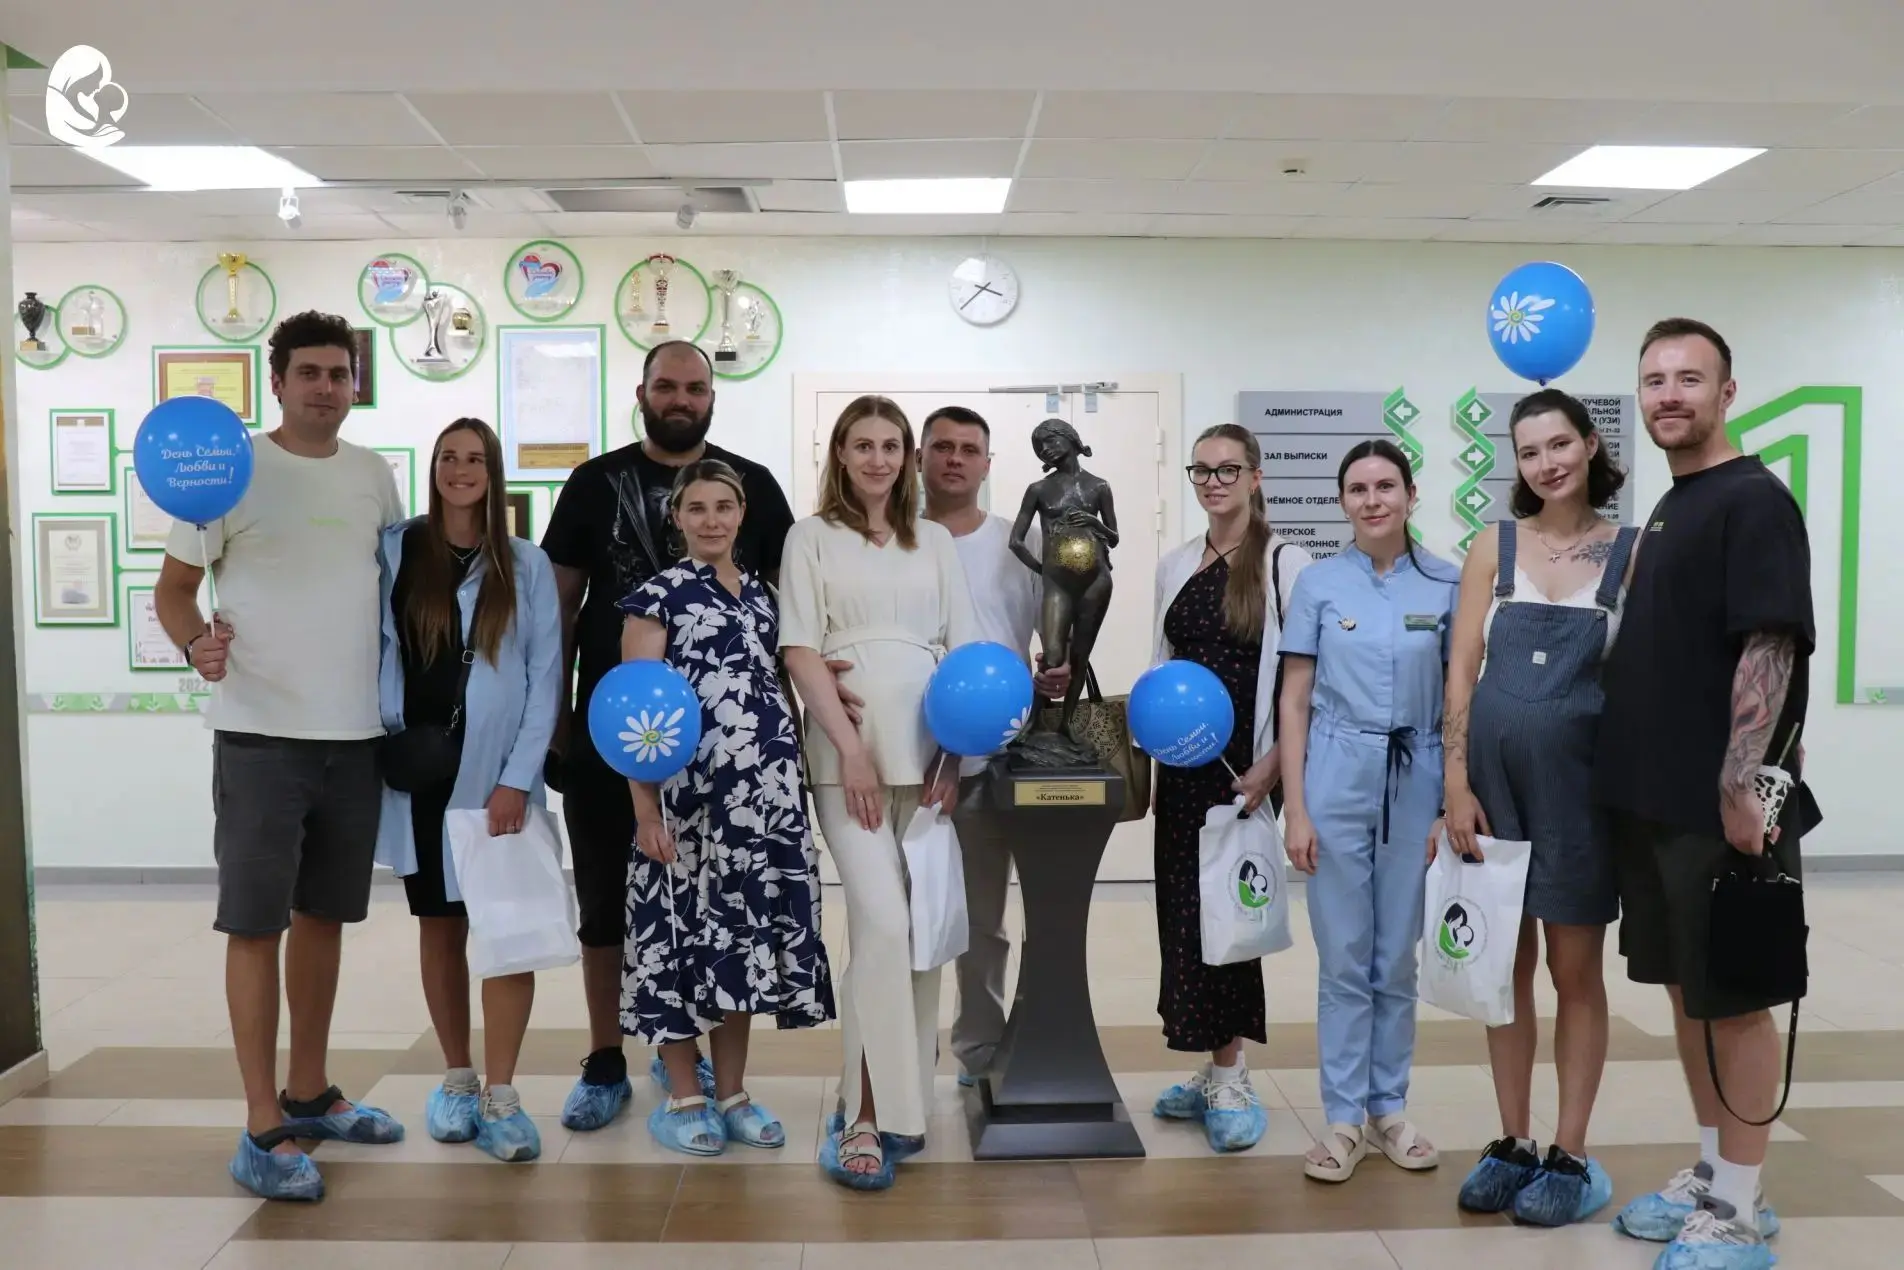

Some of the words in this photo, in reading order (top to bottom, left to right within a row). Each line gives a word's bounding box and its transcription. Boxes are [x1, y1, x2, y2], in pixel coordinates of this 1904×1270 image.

[1264, 408, 1343, 417] АДМИНИСТРАЦИЯ
[161, 448, 193, 460] День
[1264, 452, 1282, 460] ЗАЛ
[1284, 452, 1328, 460] ВЫПИСКИ
[175, 460, 217, 473] Любви
[1266, 496, 1304, 505] ИЁМНОЕ
[1305, 496, 1341, 506] ОТДЕЛЕ
